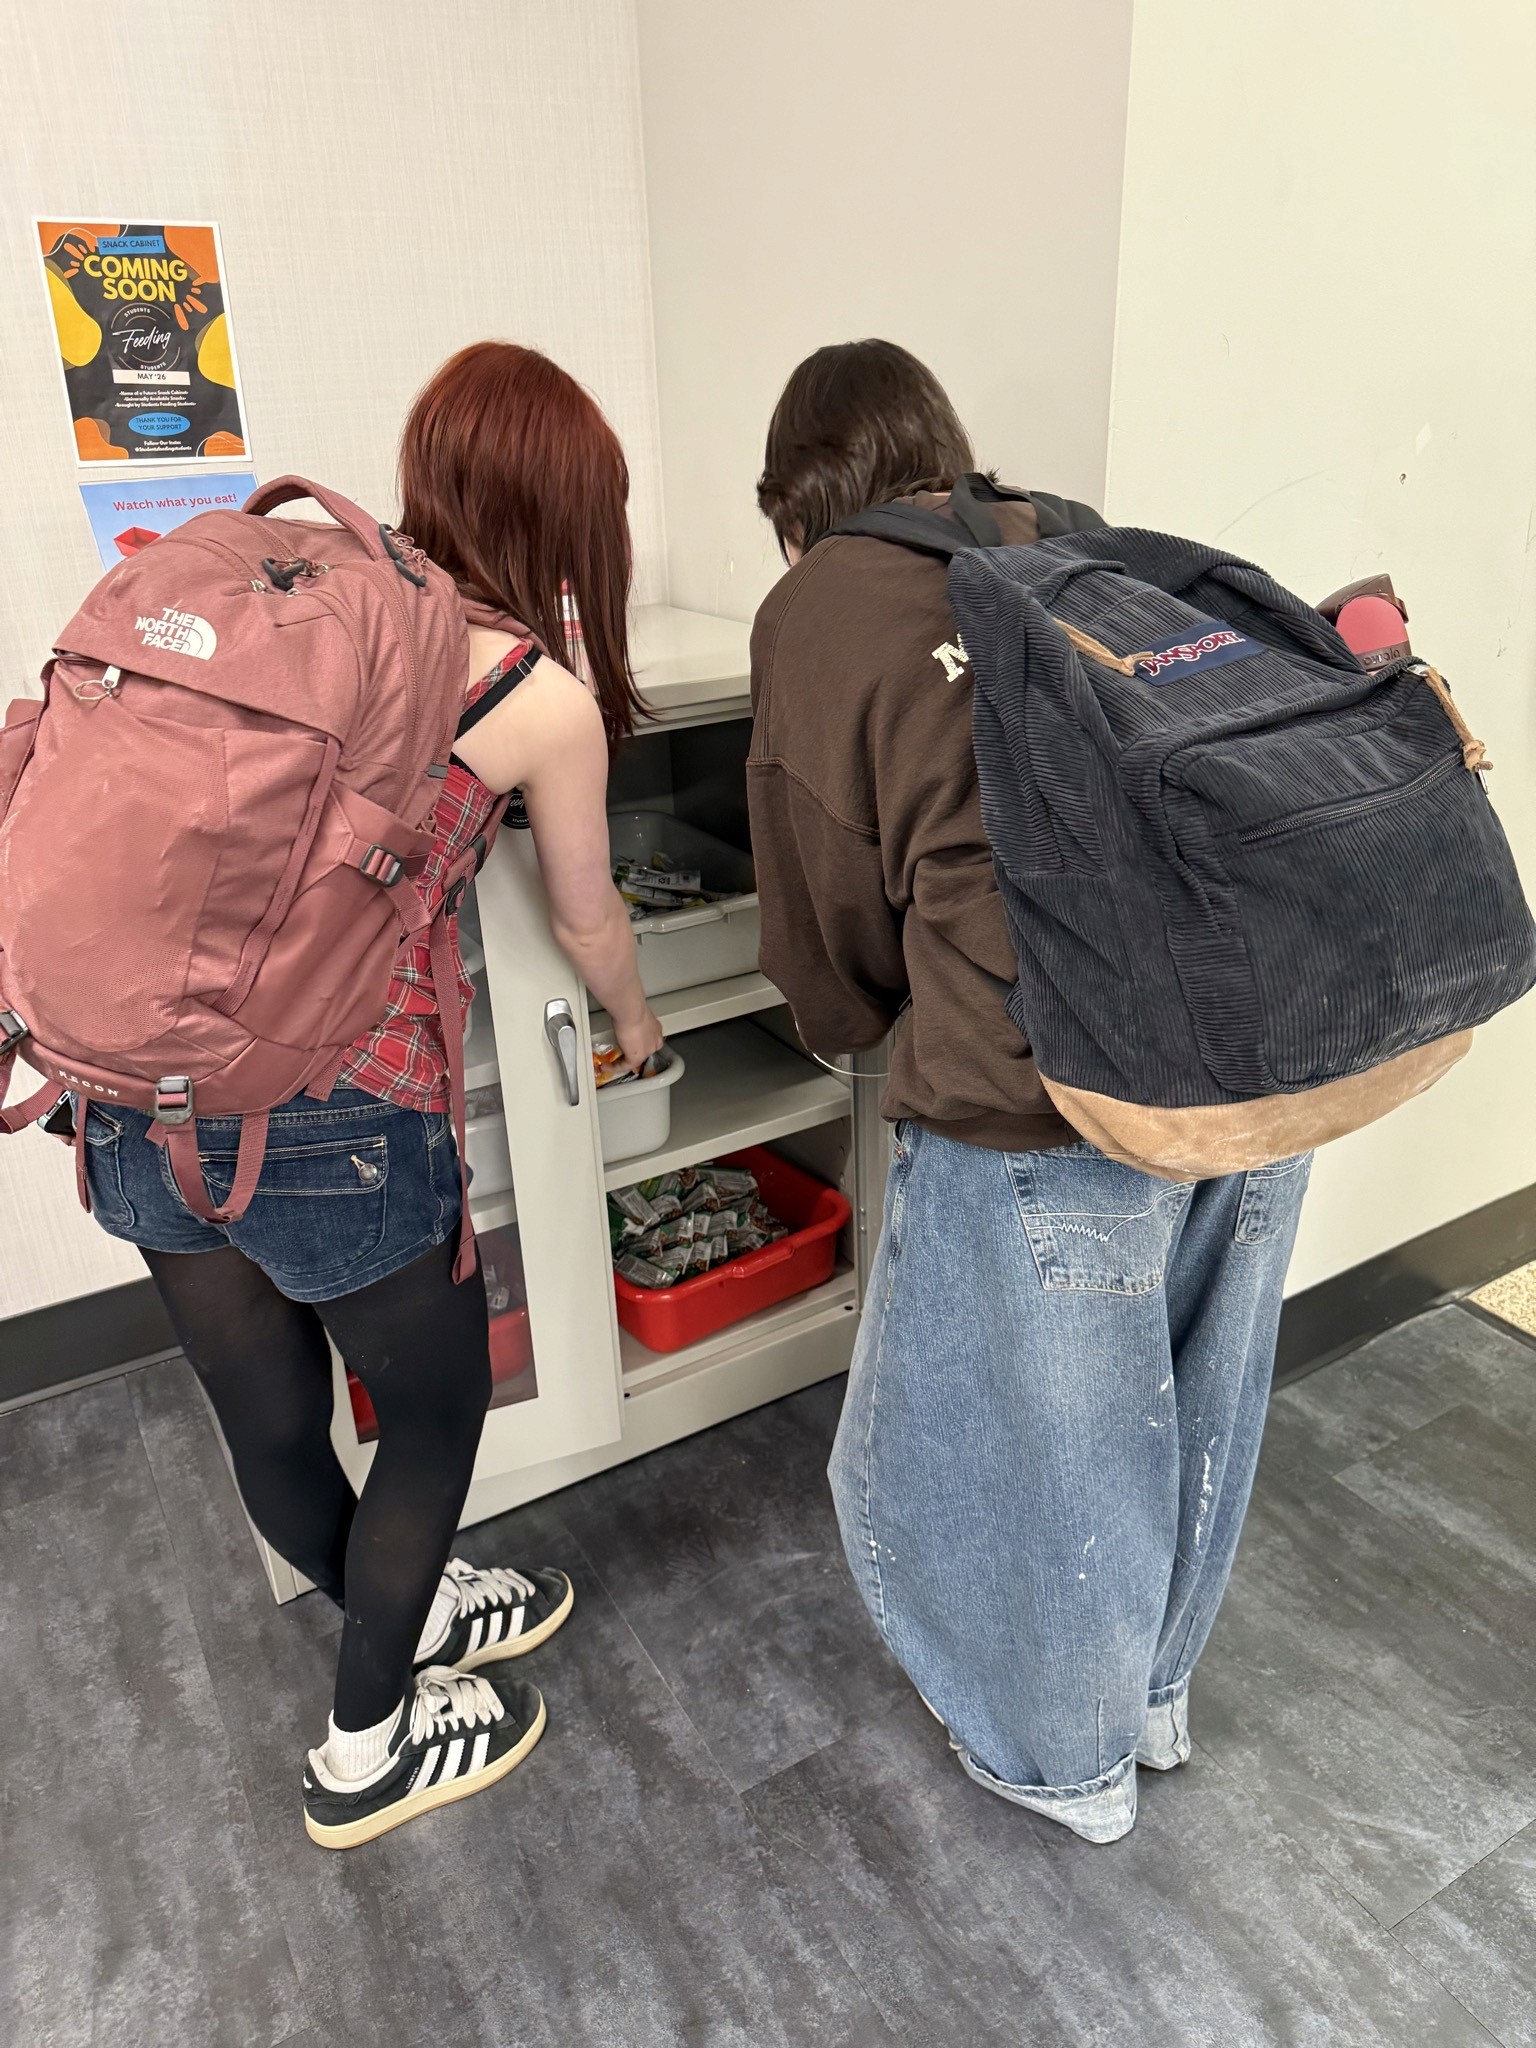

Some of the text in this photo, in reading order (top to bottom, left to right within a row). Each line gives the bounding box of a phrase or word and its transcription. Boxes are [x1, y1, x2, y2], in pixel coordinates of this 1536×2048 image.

[102, 239, 160, 249] SNACK CABINET
[83, 255, 188, 282] COMING
[102, 278, 177, 302] SOON
[123, 307, 151, 318] STUDENTS
[112, 326, 171, 354] Feeding
[137, 372, 167, 381] MAY '26
[140, 361, 167, 371] STUDENTS
[112, 493, 238, 512] Watch what you eat!
[162, 607, 196, 628] THE
[134, 616, 190, 641] NORTH
[141, 632, 185, 653] FACE
[1139, 631, 1246, 676] JANSPORT
[1363, 647, 1400, 666] owala
[58, 1070, 120, 1097] RECON
[405, 1766, 420, 1790] CAMPUS
